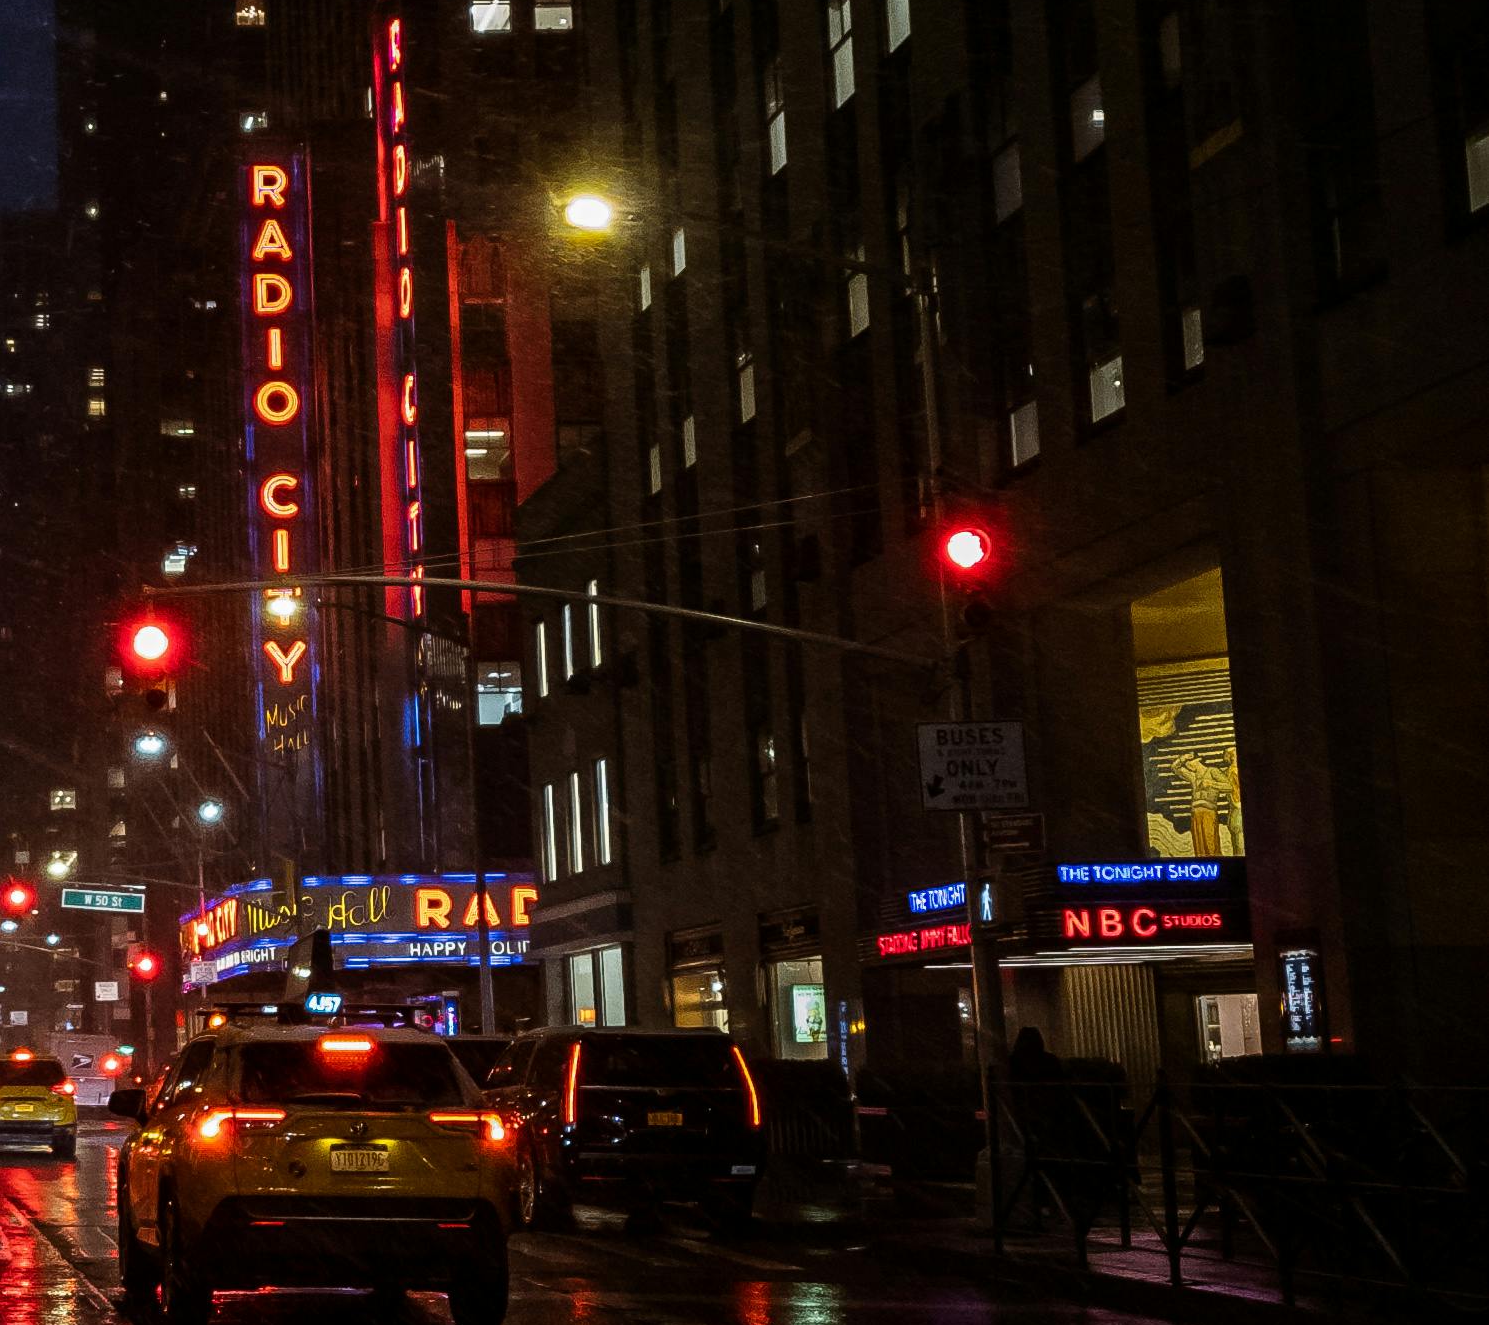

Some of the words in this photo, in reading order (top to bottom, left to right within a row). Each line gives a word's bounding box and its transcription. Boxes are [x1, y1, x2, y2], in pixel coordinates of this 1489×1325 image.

[252, 164, 299, 425] RADIO
[261, 474, 307, 684] CITY
[266, 694, 308, 733] MUSIC
[936, 727, 1004, 746] BUSES
[946, 758, 1000, 777] ONLY
[1060, 866, 1089, 881] THE
[1093, 865, 1163, 880] TONIGHT
[1167, 864, 1218, 879] SHOW
[84, 894, 93, 905] W
[95, 895, 109, 906] 50
[111, 896, 123, 907] St
[327, 885, 393, 930] Hall
[911, 891, 927, 911] THE
[927, 883, 965, 910] TONIGHT
[946, 922, 972, 946] FALLO
[1064, 908, 1158, 938] NBC
[1163, 913, 1222, 928] STUDIOS
[410, 940, 467, 957] HAPPY
[308, 995, 342, 1013] 4J57
